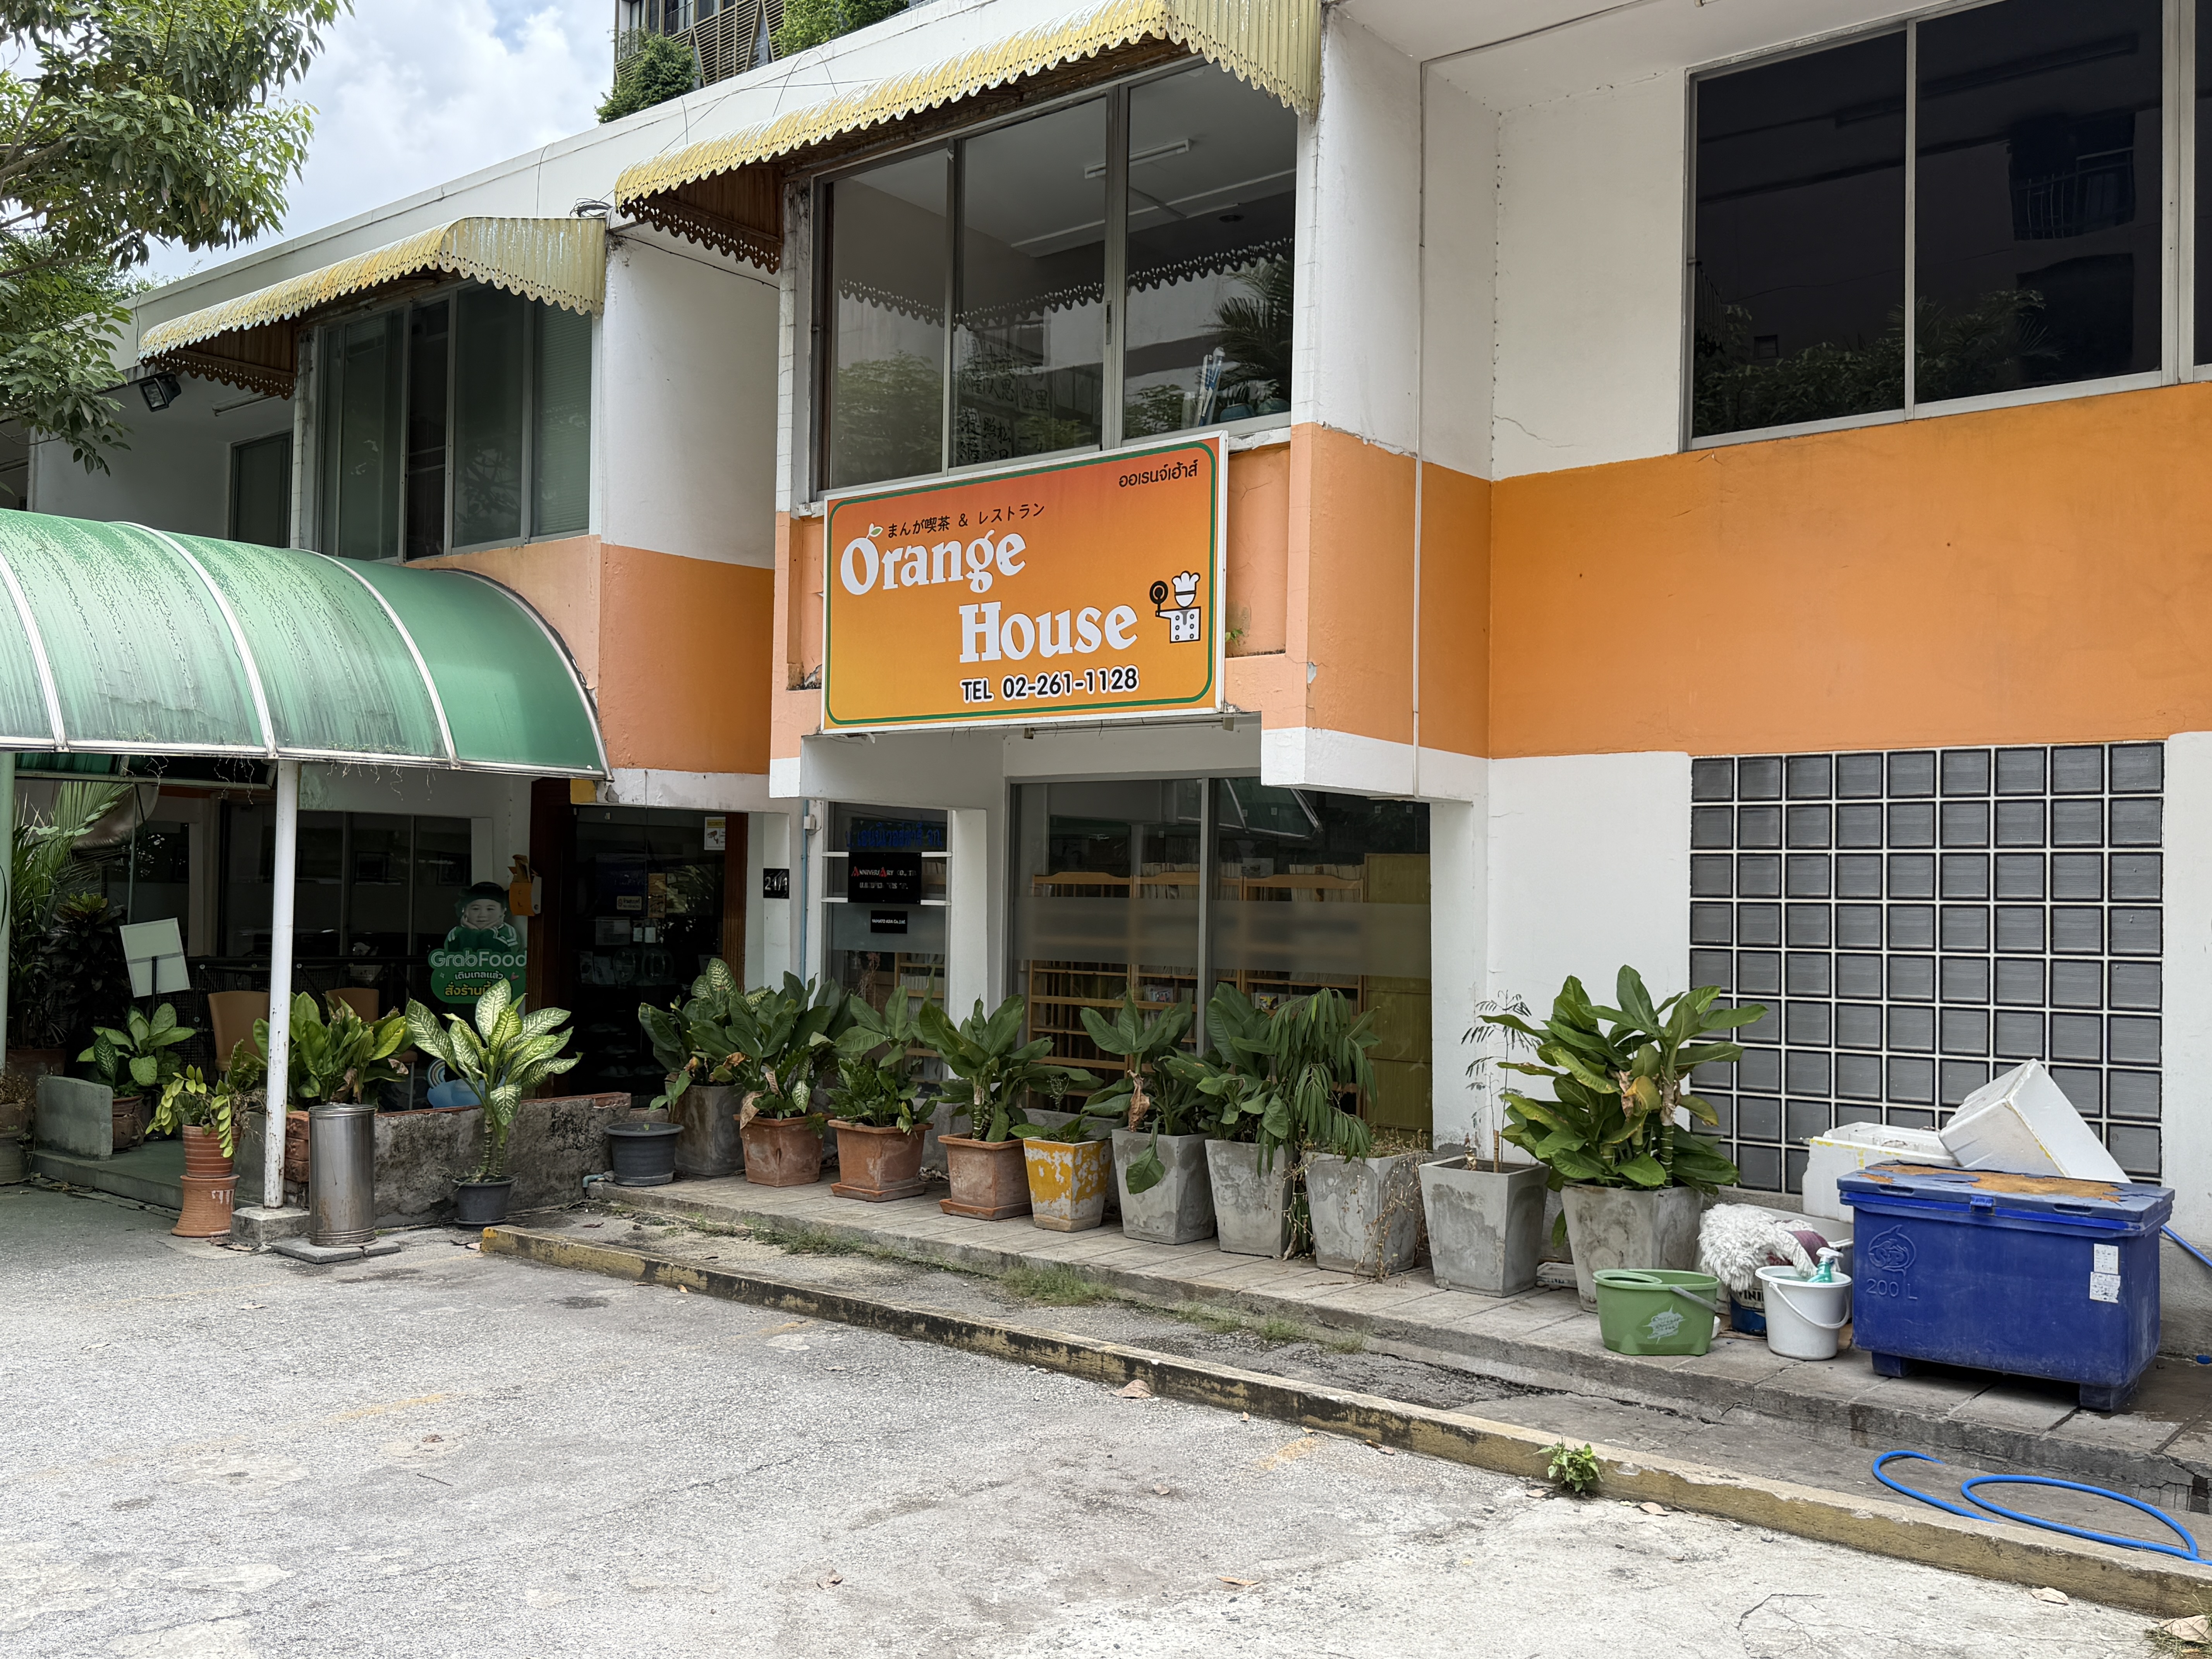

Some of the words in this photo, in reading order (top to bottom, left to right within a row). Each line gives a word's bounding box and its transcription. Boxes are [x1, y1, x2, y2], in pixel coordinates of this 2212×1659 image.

[1119, 459, 1198, 487] ออเรนจ์เฮ้าส์
[888, 515, 950, 538] まんが喫茶
[958, 513, 968, 527] &
[979, 503, 1044, 525] レストラン
[840, 529, 1026, 595] Orange
[959, 601, 1138, 663] House
[961, 679, 993, 701] TEL
[1002, 668, 1138, 699] 02-261-1128
[431, 950, 527, 967] GrabFood
[1866, 1278, 1899, 1297] 200
[1907, 1283, 1918, 1299] L
